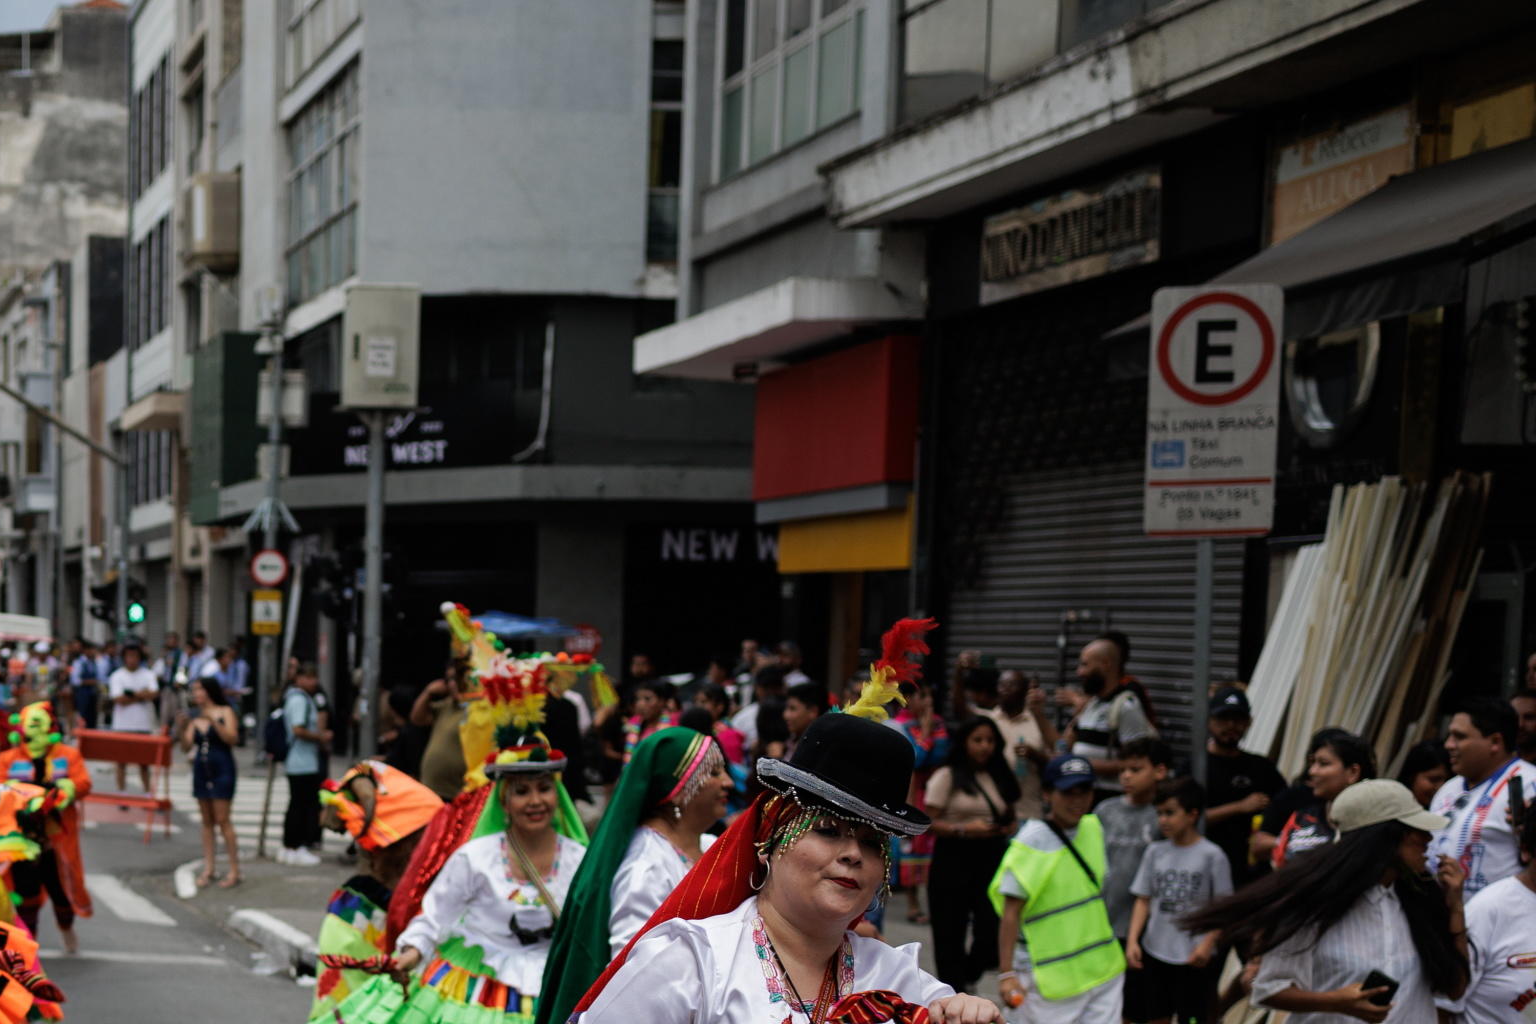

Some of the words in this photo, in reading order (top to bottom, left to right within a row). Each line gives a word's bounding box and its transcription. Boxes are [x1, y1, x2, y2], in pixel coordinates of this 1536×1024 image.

[1196, 320, 1236, 382] E
[1172, 417, 1214, 432] LINHA
[391, 439, 449, 464] WEST
[660, 527, 740, 562] NEW
